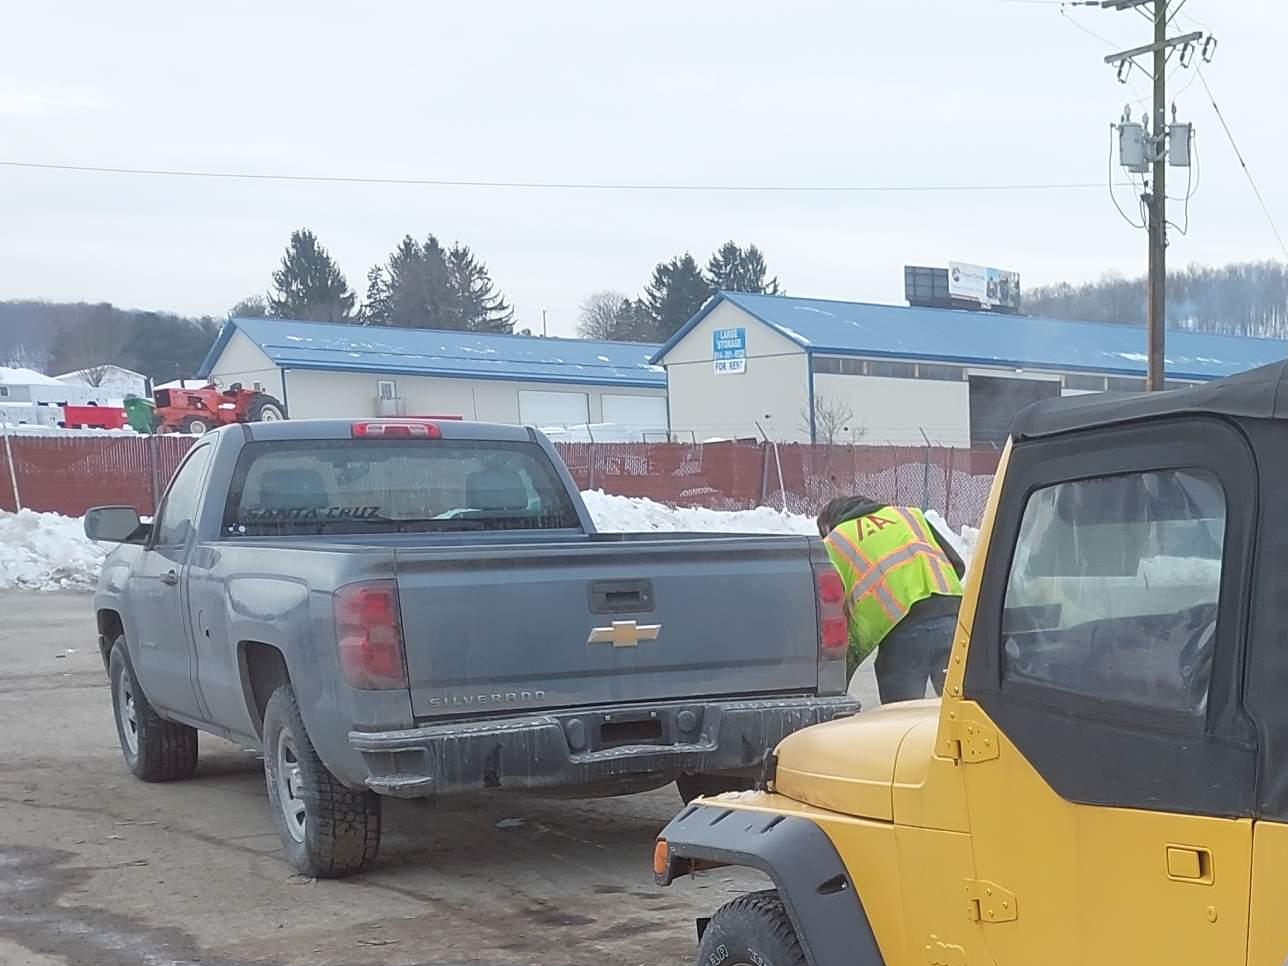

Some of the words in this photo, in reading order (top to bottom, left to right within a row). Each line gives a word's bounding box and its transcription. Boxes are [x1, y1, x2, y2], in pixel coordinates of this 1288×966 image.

[715, 361, 727, 371] FOR
[729, 360, 744, 370] RENT
[247, 507, 320, 520] SANTA
[326, 506, 382, 519] CRUZ
[430, 690, 546, 707] SILVERADO
